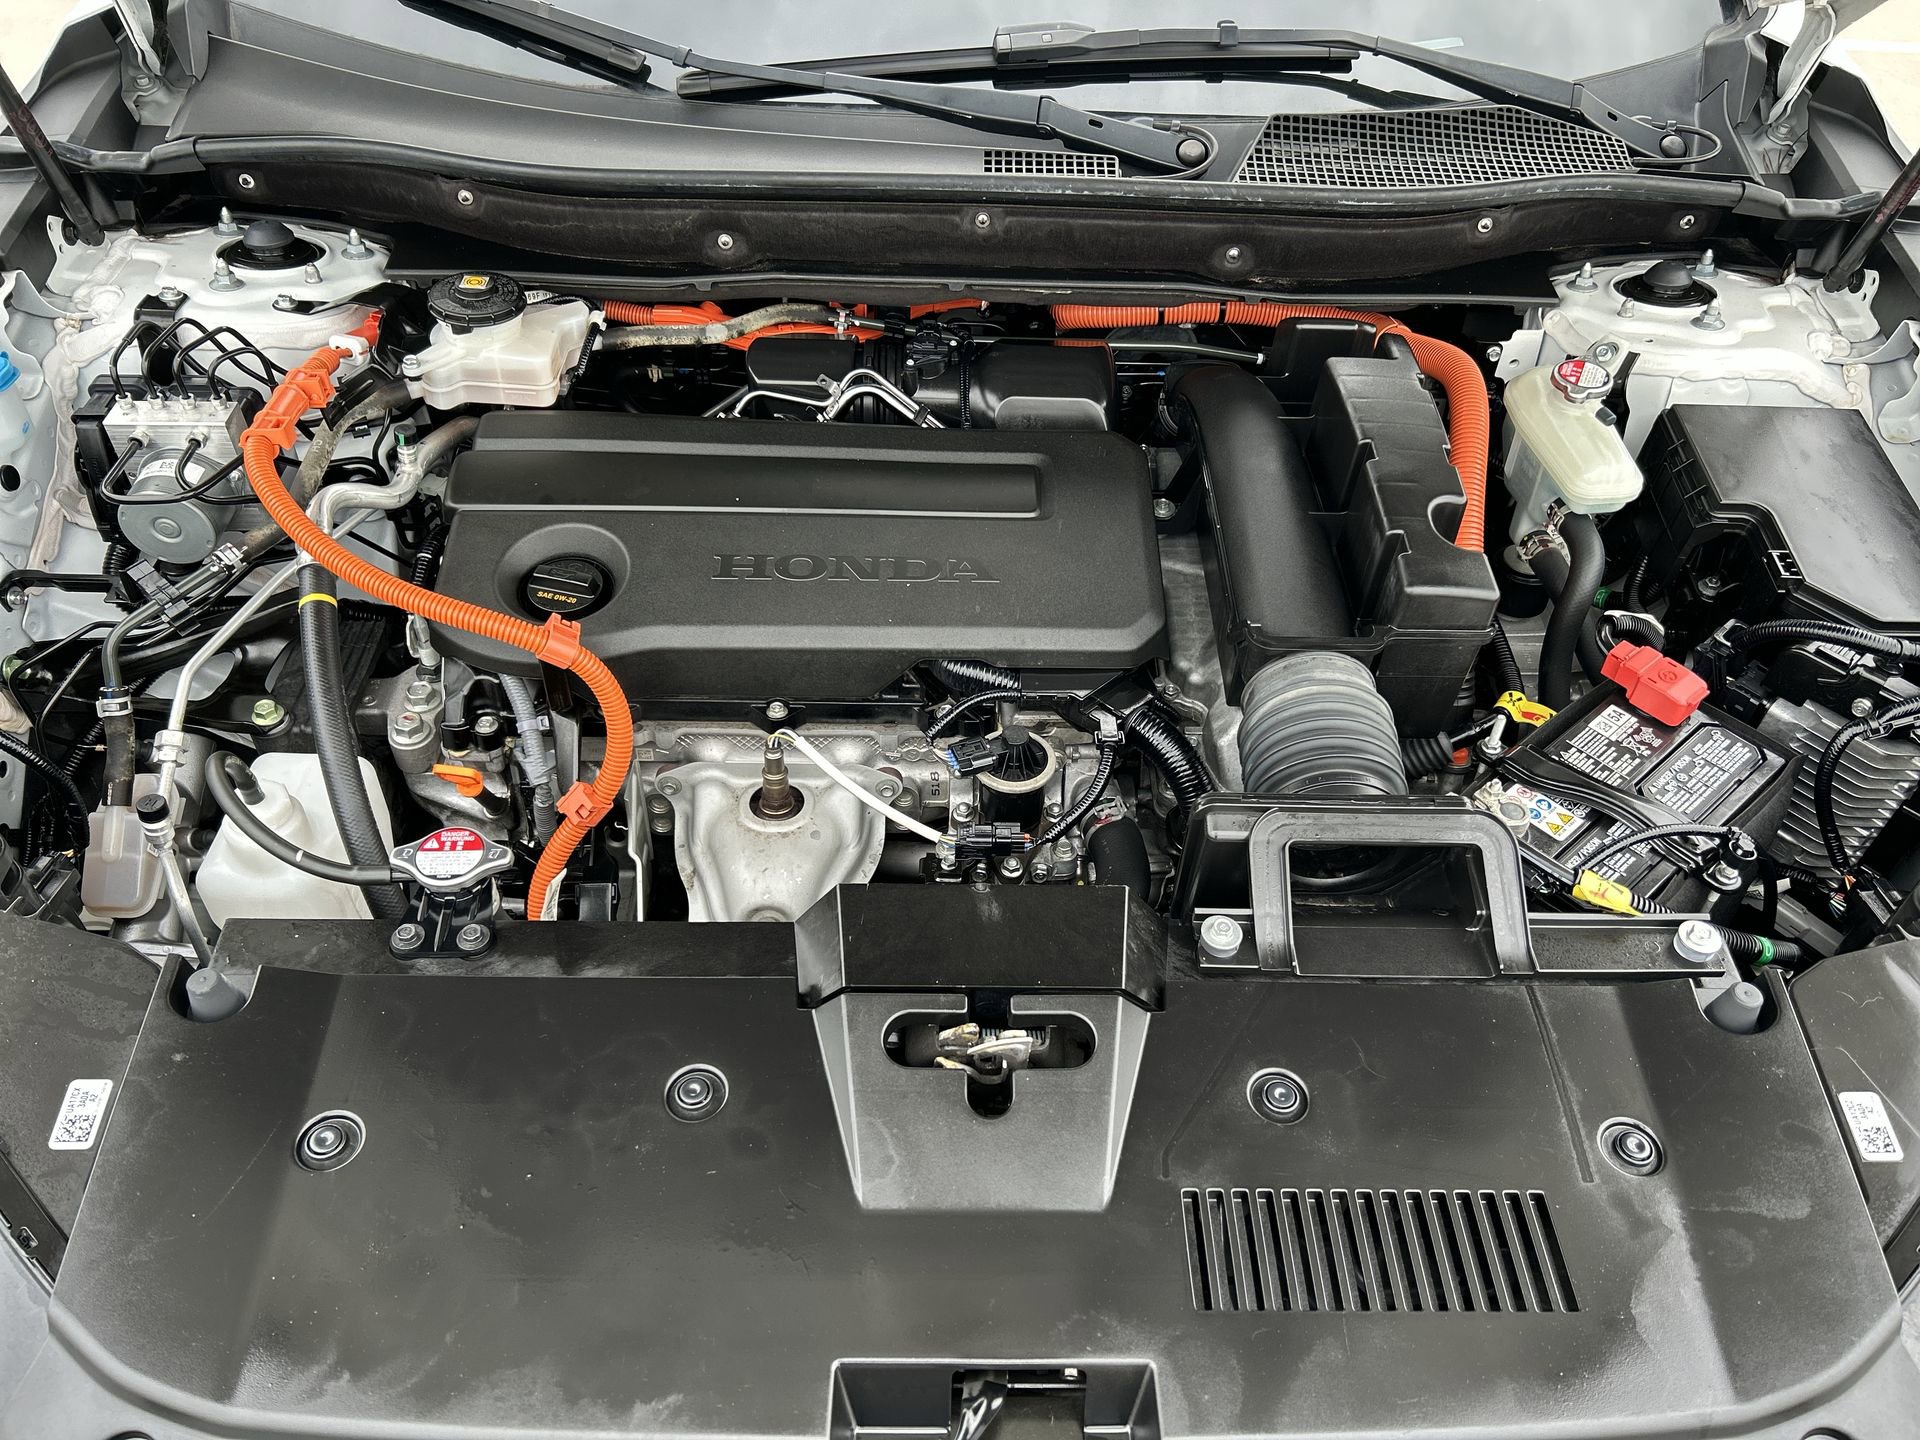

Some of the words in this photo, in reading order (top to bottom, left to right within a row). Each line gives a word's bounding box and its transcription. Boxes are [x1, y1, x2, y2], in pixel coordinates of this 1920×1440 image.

[711, 554, 1000, 583] HONDA
[536, 591, 553, 600] SAE
[554, 593, 577, 604] 0W-20
[1607, 709, 1626, 722] 5A
[930, 771, 940, 796] 518
